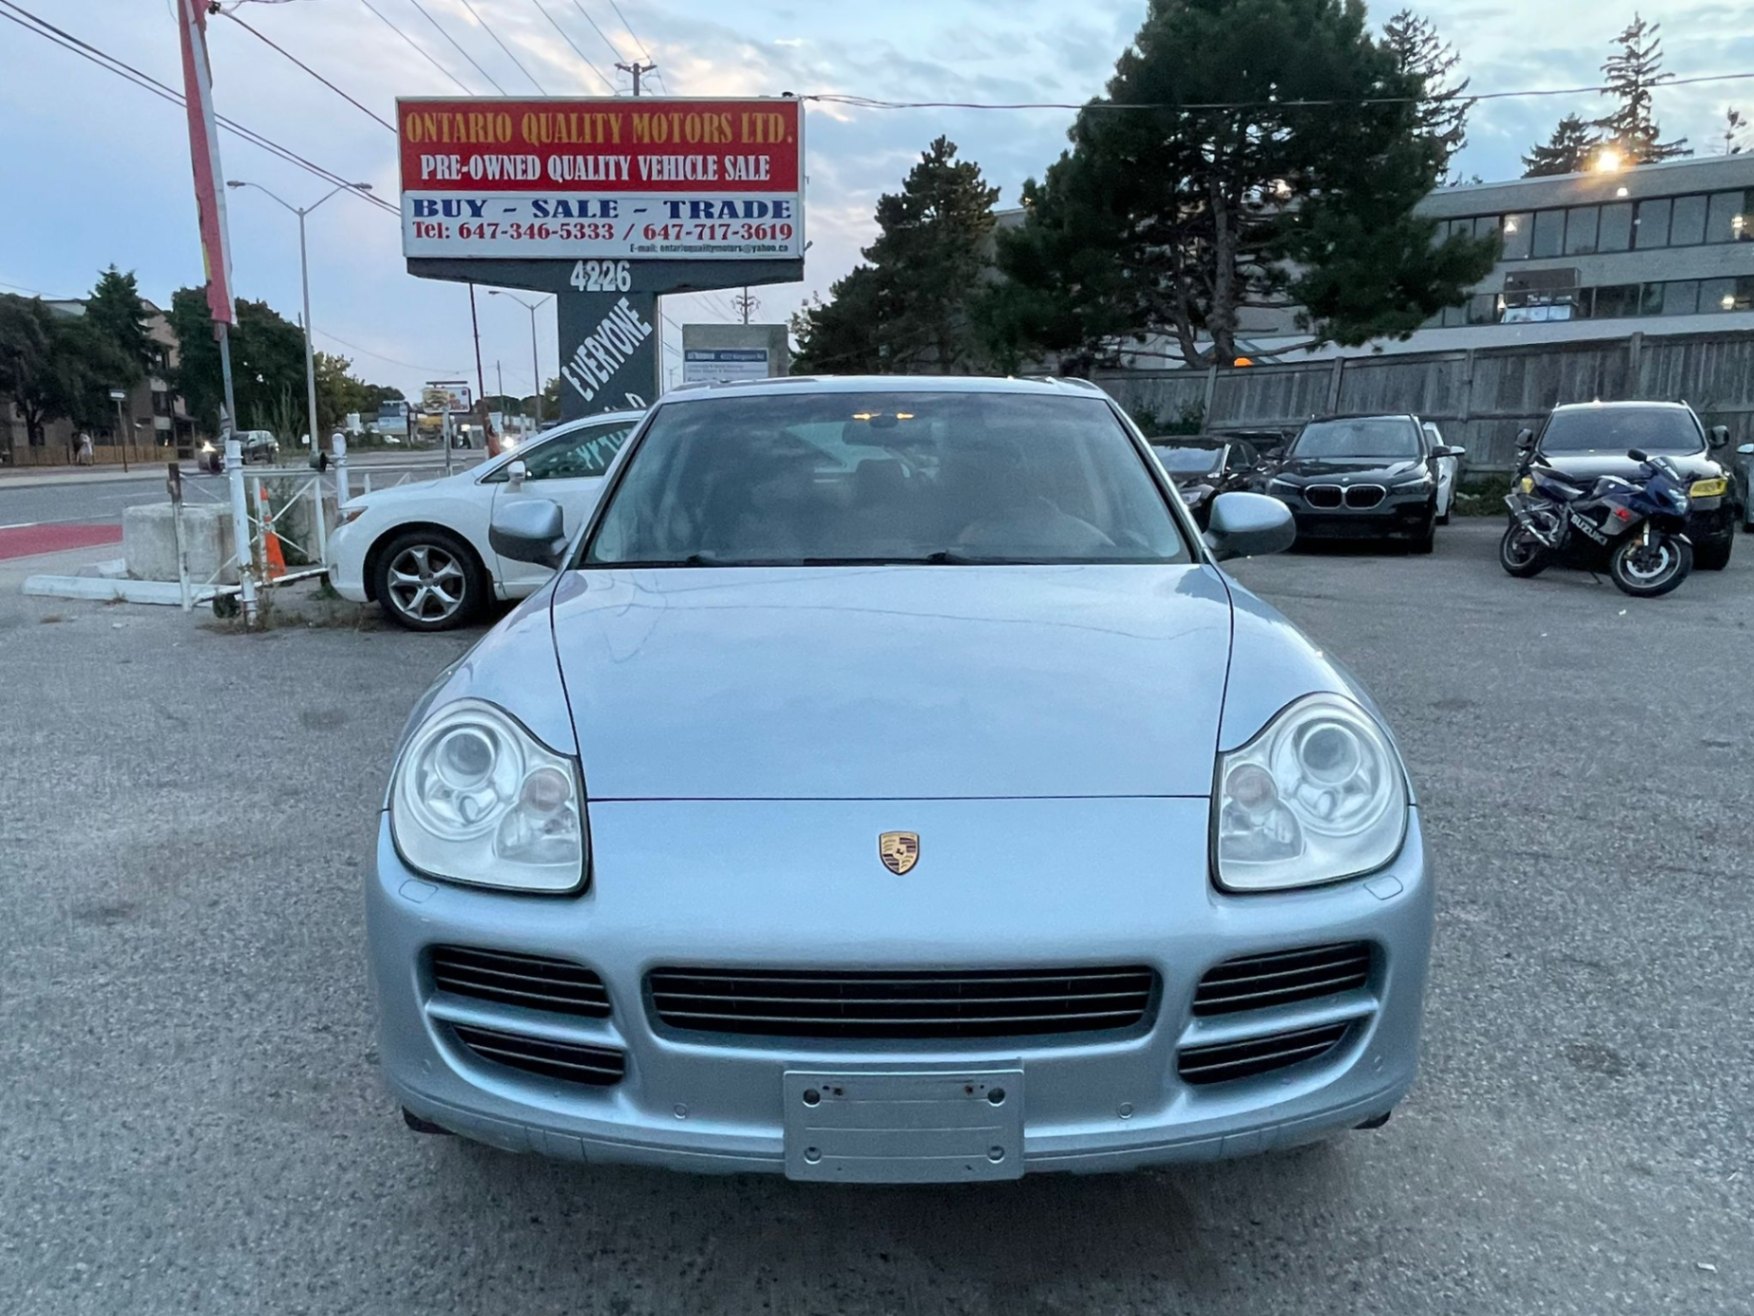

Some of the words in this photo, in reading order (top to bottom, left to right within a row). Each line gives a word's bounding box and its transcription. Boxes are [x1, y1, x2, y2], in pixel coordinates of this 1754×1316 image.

[405, 112, 513, 144] ONTARIO
[521, 112, 622, 147] QUALITY
[632, 112, 733, 144] MOTORS
[741, 112, 793, 144] LTD.
[420, 154, 541, 181] PRE-OWNED
[547, 154, 631, 183] QUALITY
[637, 154, 719, 181] VEHICLE
[724, 154, 771, 181] SALE
[412, 199, 488, 218] BUY
[531, 199, 619, 219] SALE
[663, 200, 792, 220] TRADE
[412, 221, 450, 240] Tel:
[458, 221, 615, 240] 647-346-5333
[643, 222, 793, 241] 647-717-3619
[569, 260, 632, 292] 4226
[561, 296, 653, 402] EVERYONE
[1570, 513, 1608, 546] SUZUKI
